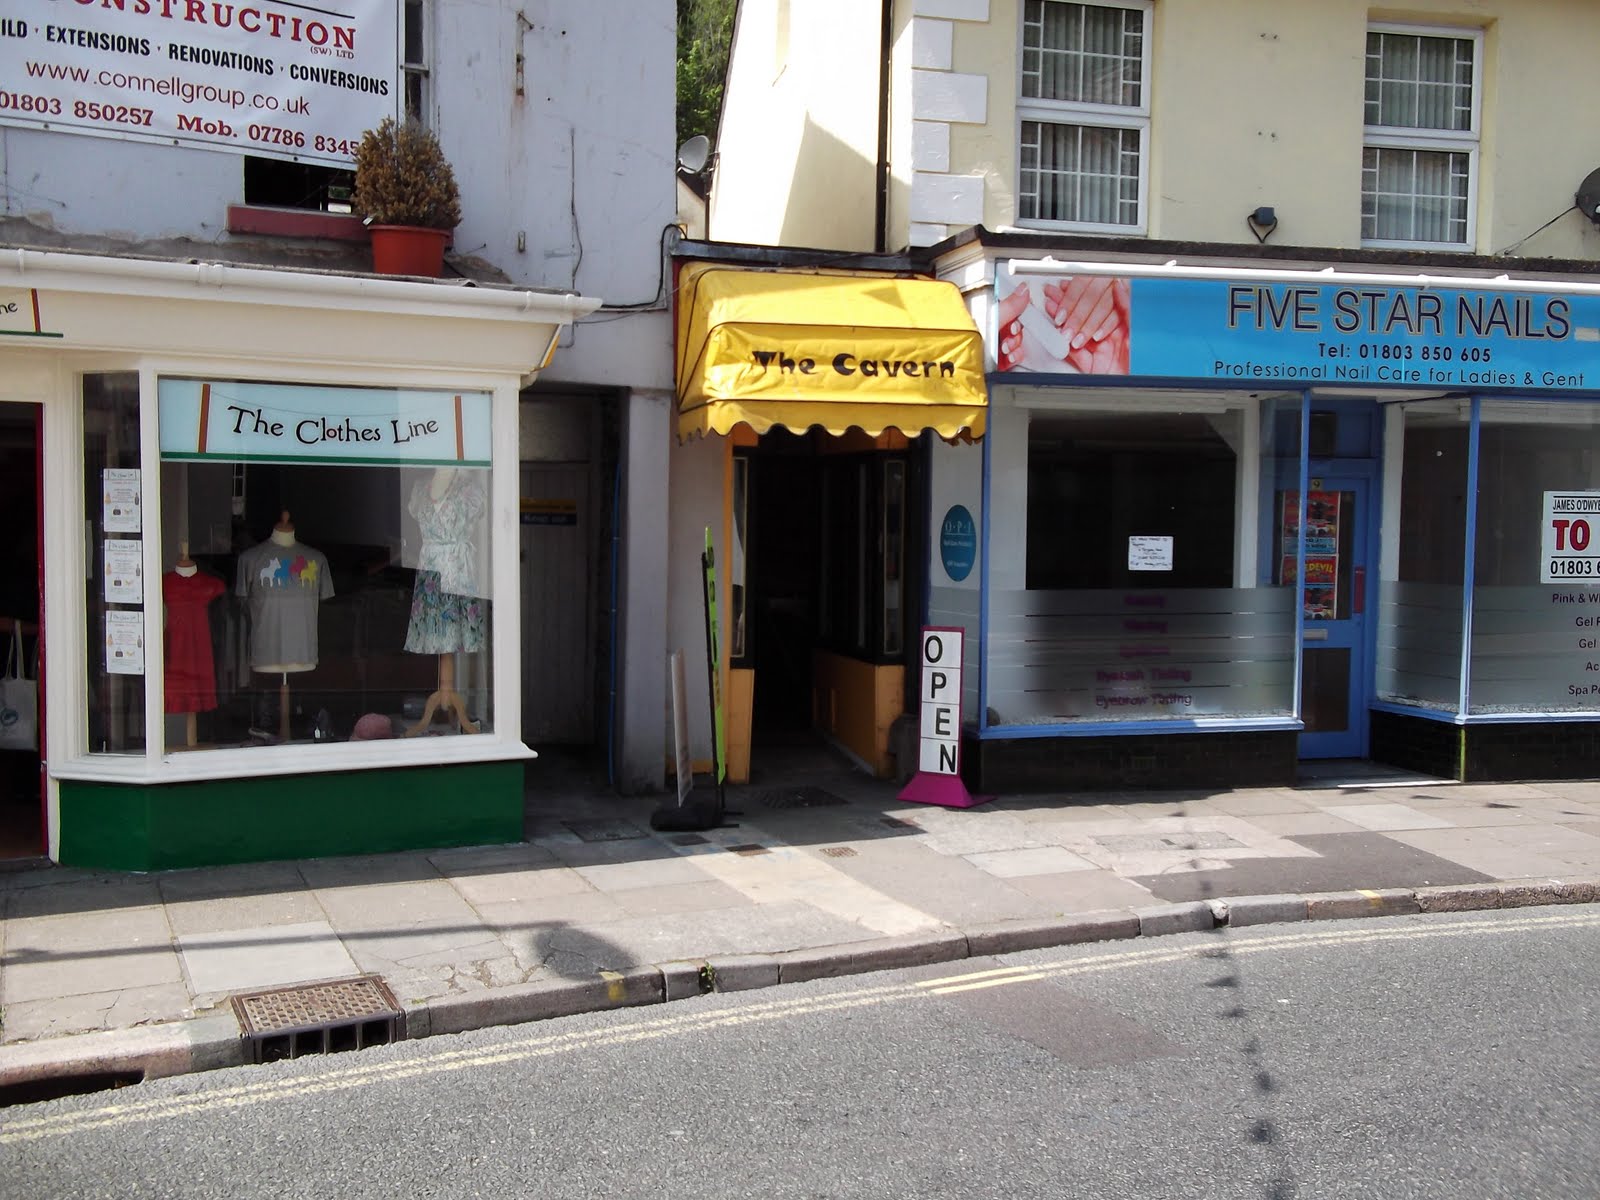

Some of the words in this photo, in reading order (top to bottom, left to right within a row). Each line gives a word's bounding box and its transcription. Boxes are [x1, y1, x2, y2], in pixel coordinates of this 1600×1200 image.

[72, 0, 357, 50] STRUCTION
[46, 24, 151, 56] EXTENSIONS
[168, 43, 274, 76] RENOVATIONS
[289, 63, 389, 96] CONVERSIONS
[310, 45, 332, 57] (SW)
[336, 50, 355, 60] LTD
[25, 60, 311, 117] www.connellgroup.co.uk
[0, 90, 63, 116] 01803
[73, 100, 154, 127] 850257
[176, 113, 238, 138] Mob.
[248, 123, 306, 148] 07786
[314, 134, 361, 158] 8345
[1227, 284, 1321, 331] FIVE
[1331, 288, 1444, 337] STAR
[1455, 294, 1571, 340] NAILS
[752, 350, 817, 375] The
[831, 352, 956, 378] Cavern
[1318, 342, 1351, 359] Tel:
[1359, 344, 1414, 361] 01803
[1421, 346, 1452, 362] 850
[1460, 347, 1492, 363] 605
[1214, 360, 1328, 379] Professional
[1335, 365, 1371, 381] Nail
[1376, 366, 1420, 383] Care
[1428, 367, 1452, 383] for
[1459, 368, 1516, 385] Ladies
[1523, 372, 1534, 385] &
[1541, 371, 1585, 387] Gent
[226, 405, 285, 437] The
[295, 416, 382, 445] Clothes
[390, 417, 440, 444] Line
[1552, 498, 1576, 512] JAMES
[1552, 518, 1591, 551] TO
[1550, 560, 1592, 575] 01803
[1552, 592, 1575, 604] Pink
[1578, 593, 1586, 604] &
[1587, 594, 1600, 605] W
[1575, 616, 1594, 627] Gel
[1578, 638, 1597, 649] Gel
[924, 635, 957, 773] OPEN
[1568, 684, 1589, 697] Spa
